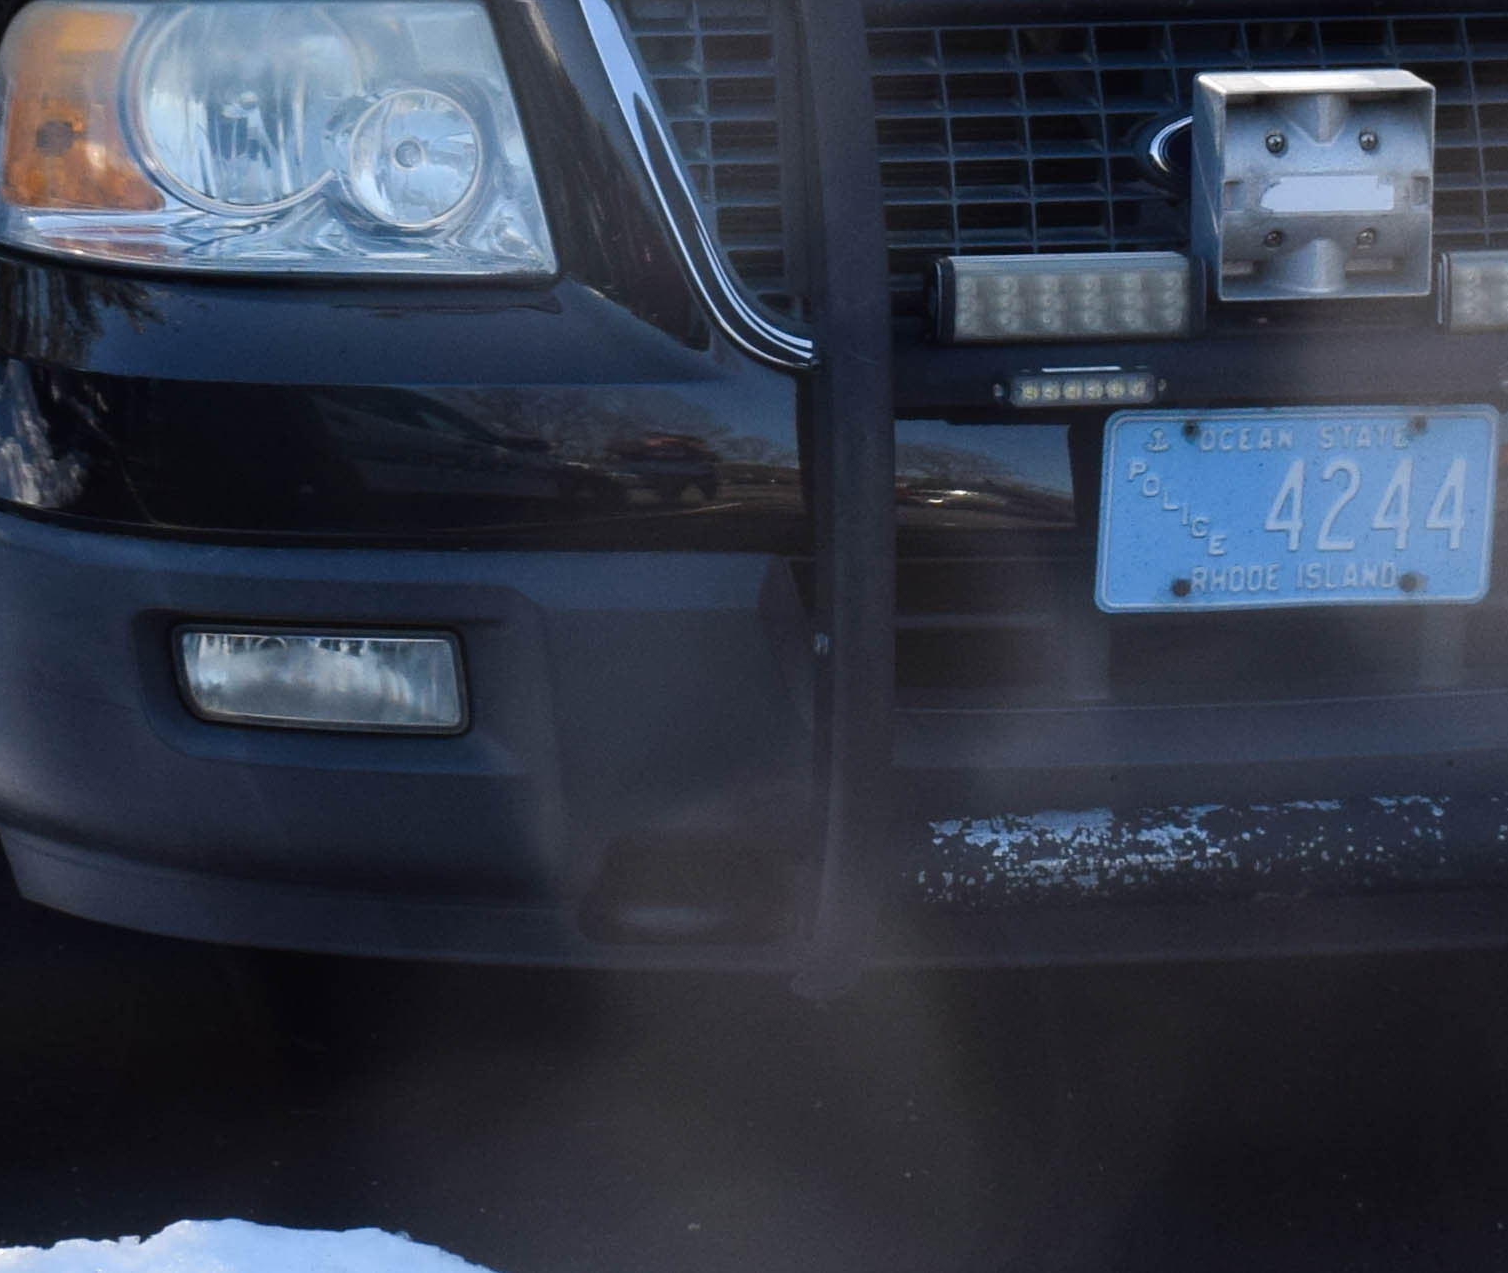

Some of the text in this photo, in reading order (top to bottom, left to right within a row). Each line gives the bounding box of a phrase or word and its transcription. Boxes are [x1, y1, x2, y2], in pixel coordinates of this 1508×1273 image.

[1199, 423, 1410, 452] OCEAN STATE
[1126, 457, 1229, 557] POLICE
[1263, 455, 1468, 552] 4244
[1191, 559, 1397, 593] RHODE ISLAND
